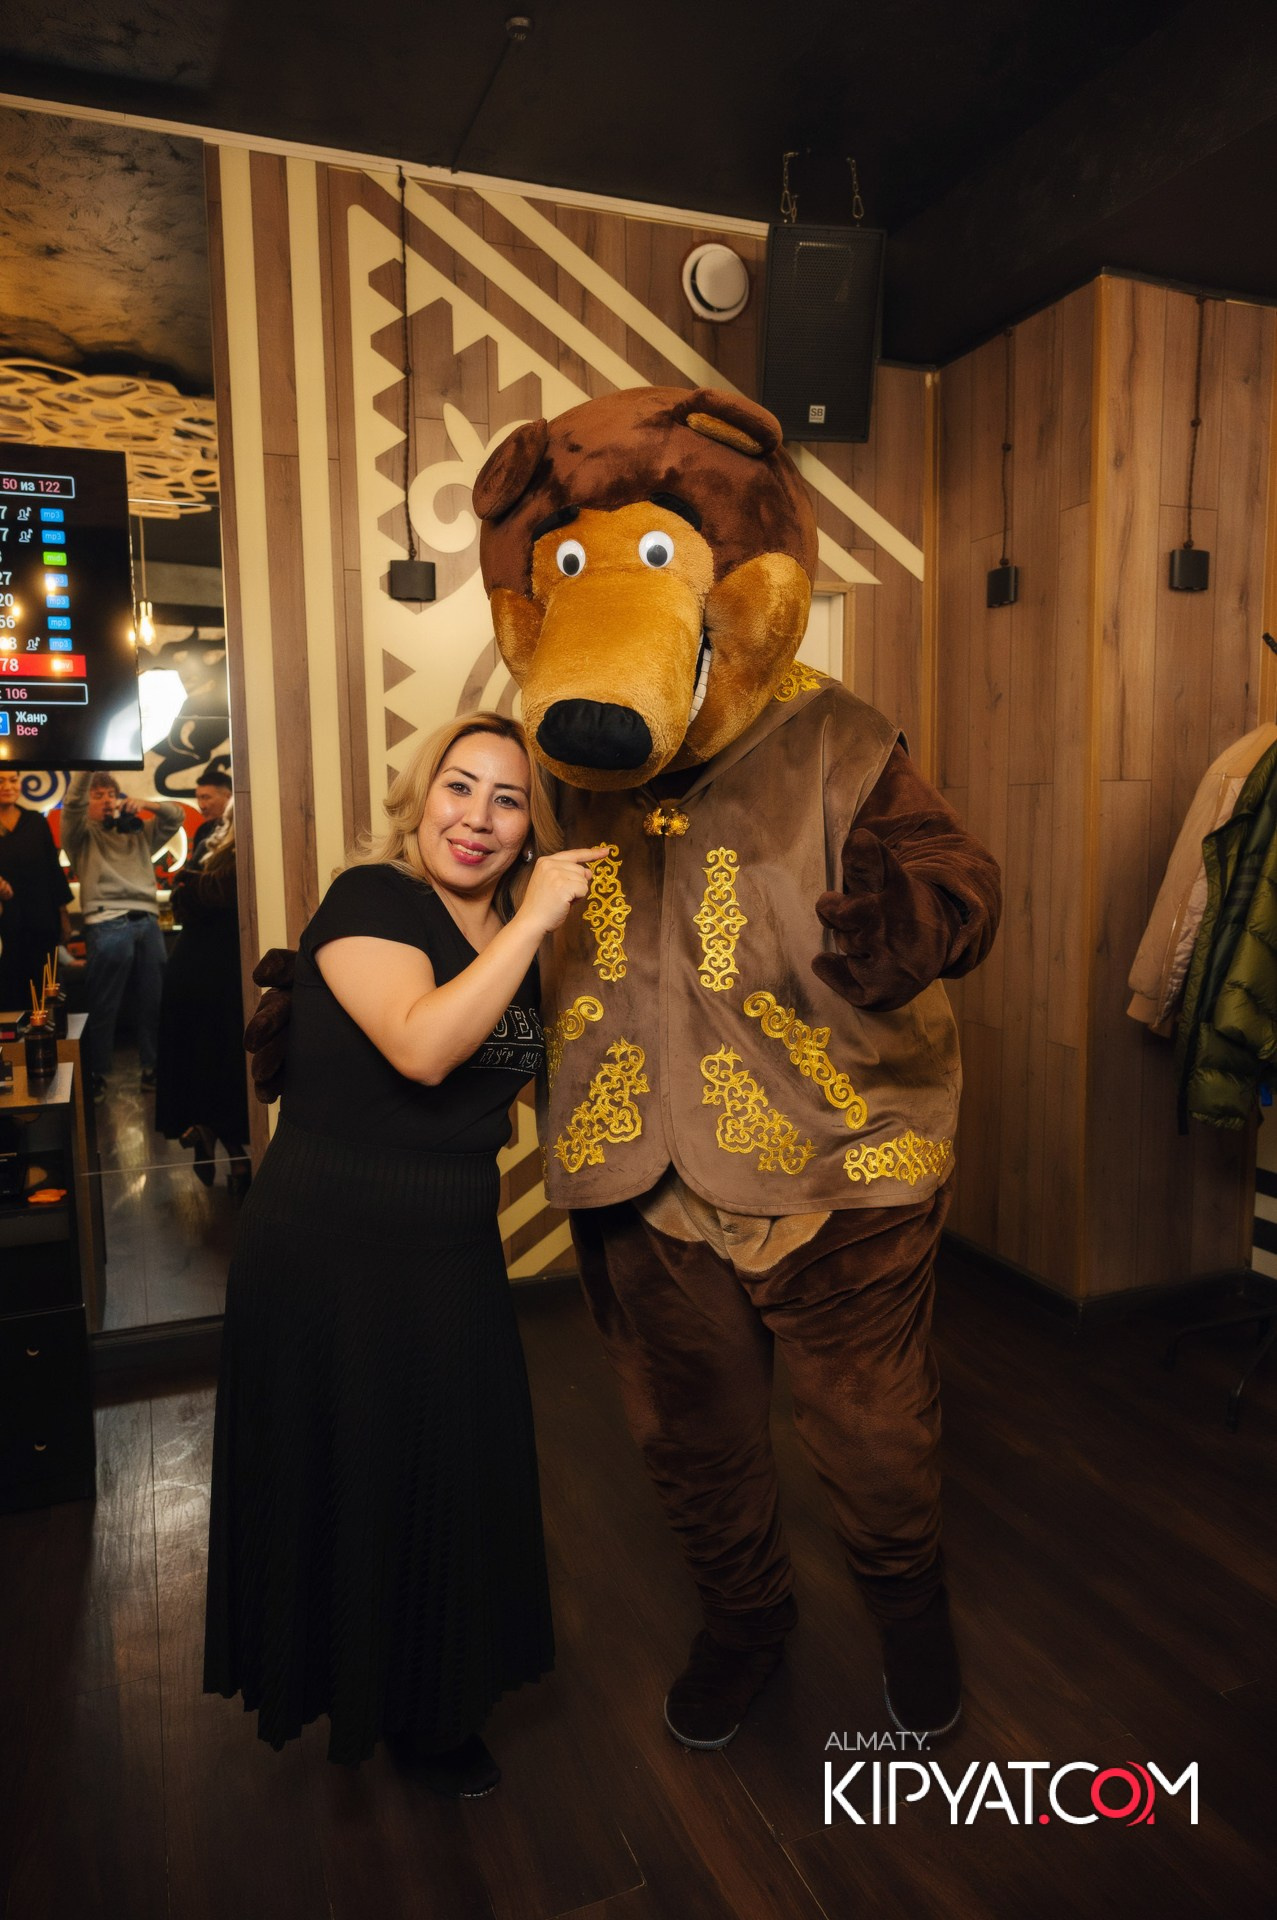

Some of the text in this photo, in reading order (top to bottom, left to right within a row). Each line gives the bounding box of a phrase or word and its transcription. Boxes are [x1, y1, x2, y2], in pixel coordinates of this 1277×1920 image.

[811, 408, 823, 416] SB
[2, 478, 61, 493] 50 из 122
[49, 597, 66, 606] mp3
[50, 619, 67, 627] mp3
[52, 640, 69, 648] mp3
[5, 687, 28, 700] 106
[15, 711, 48, 725] Жанр
[16, 724, 39, 736] Все
